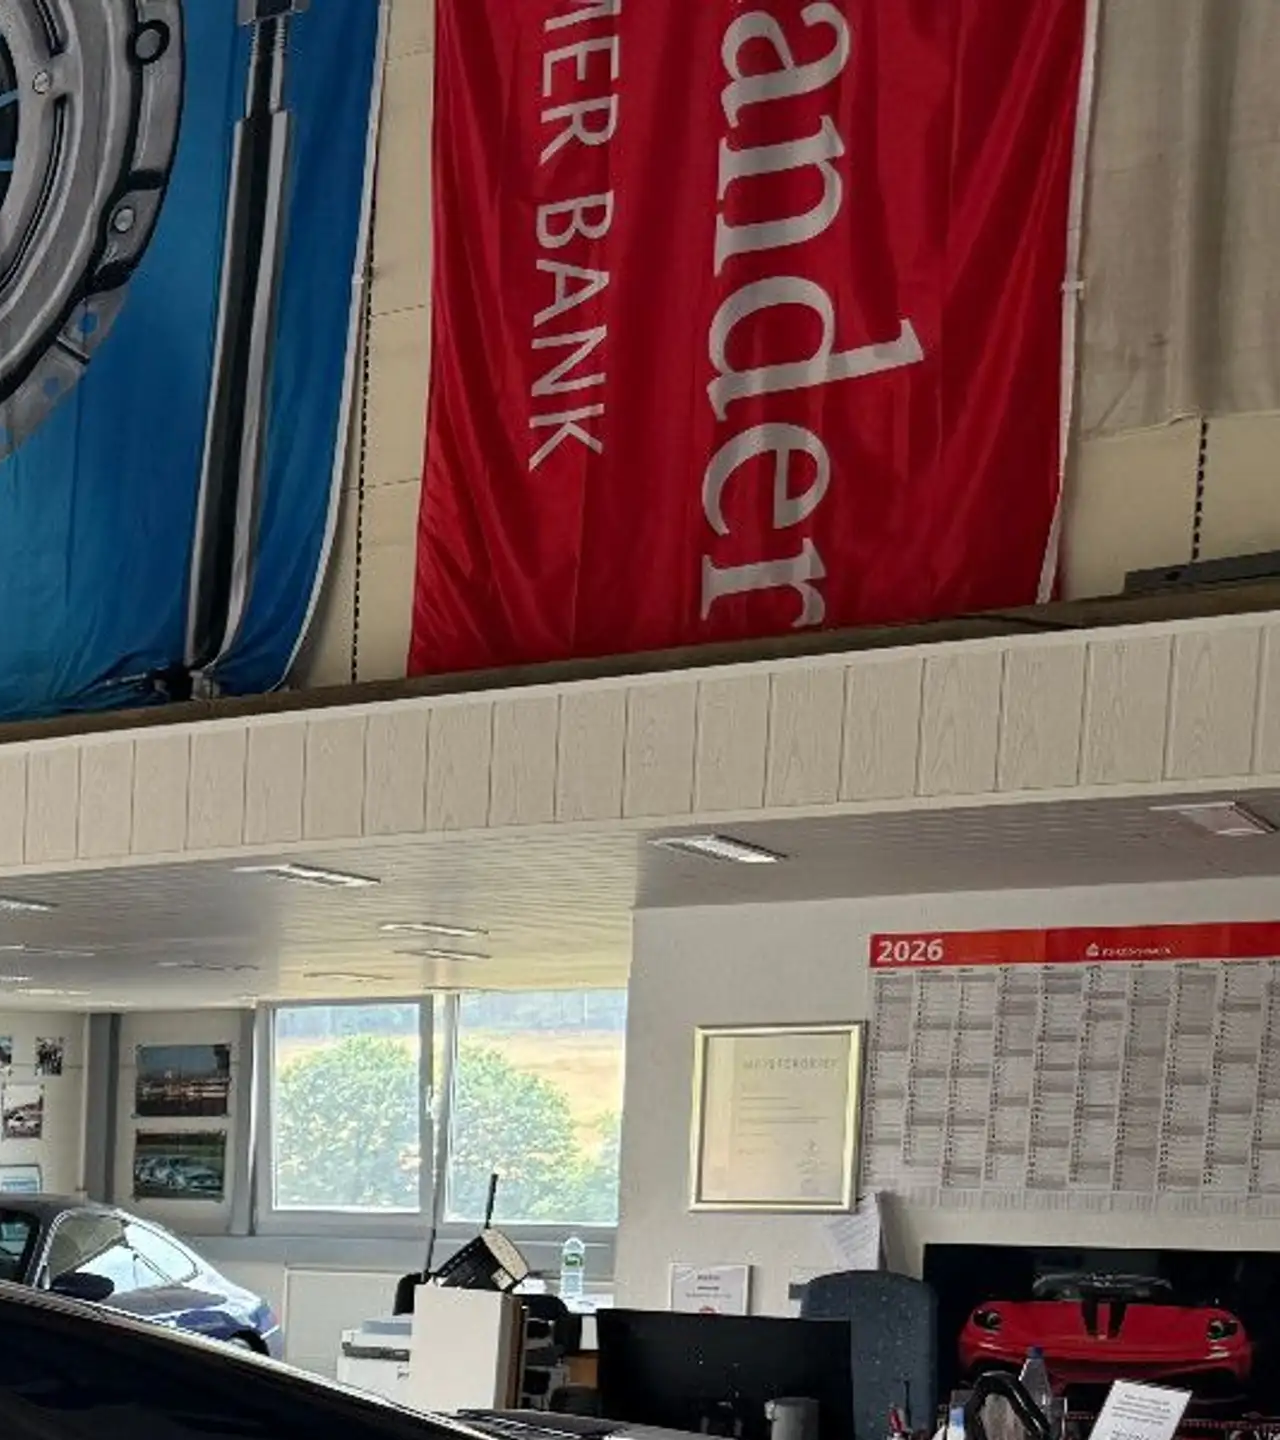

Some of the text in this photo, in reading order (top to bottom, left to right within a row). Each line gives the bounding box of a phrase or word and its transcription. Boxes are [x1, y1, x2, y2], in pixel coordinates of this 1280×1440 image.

[528, 191, 615, 472] BANK
[701, 0, 925, 628] ander
[876, 938, 944, 963] 2026
